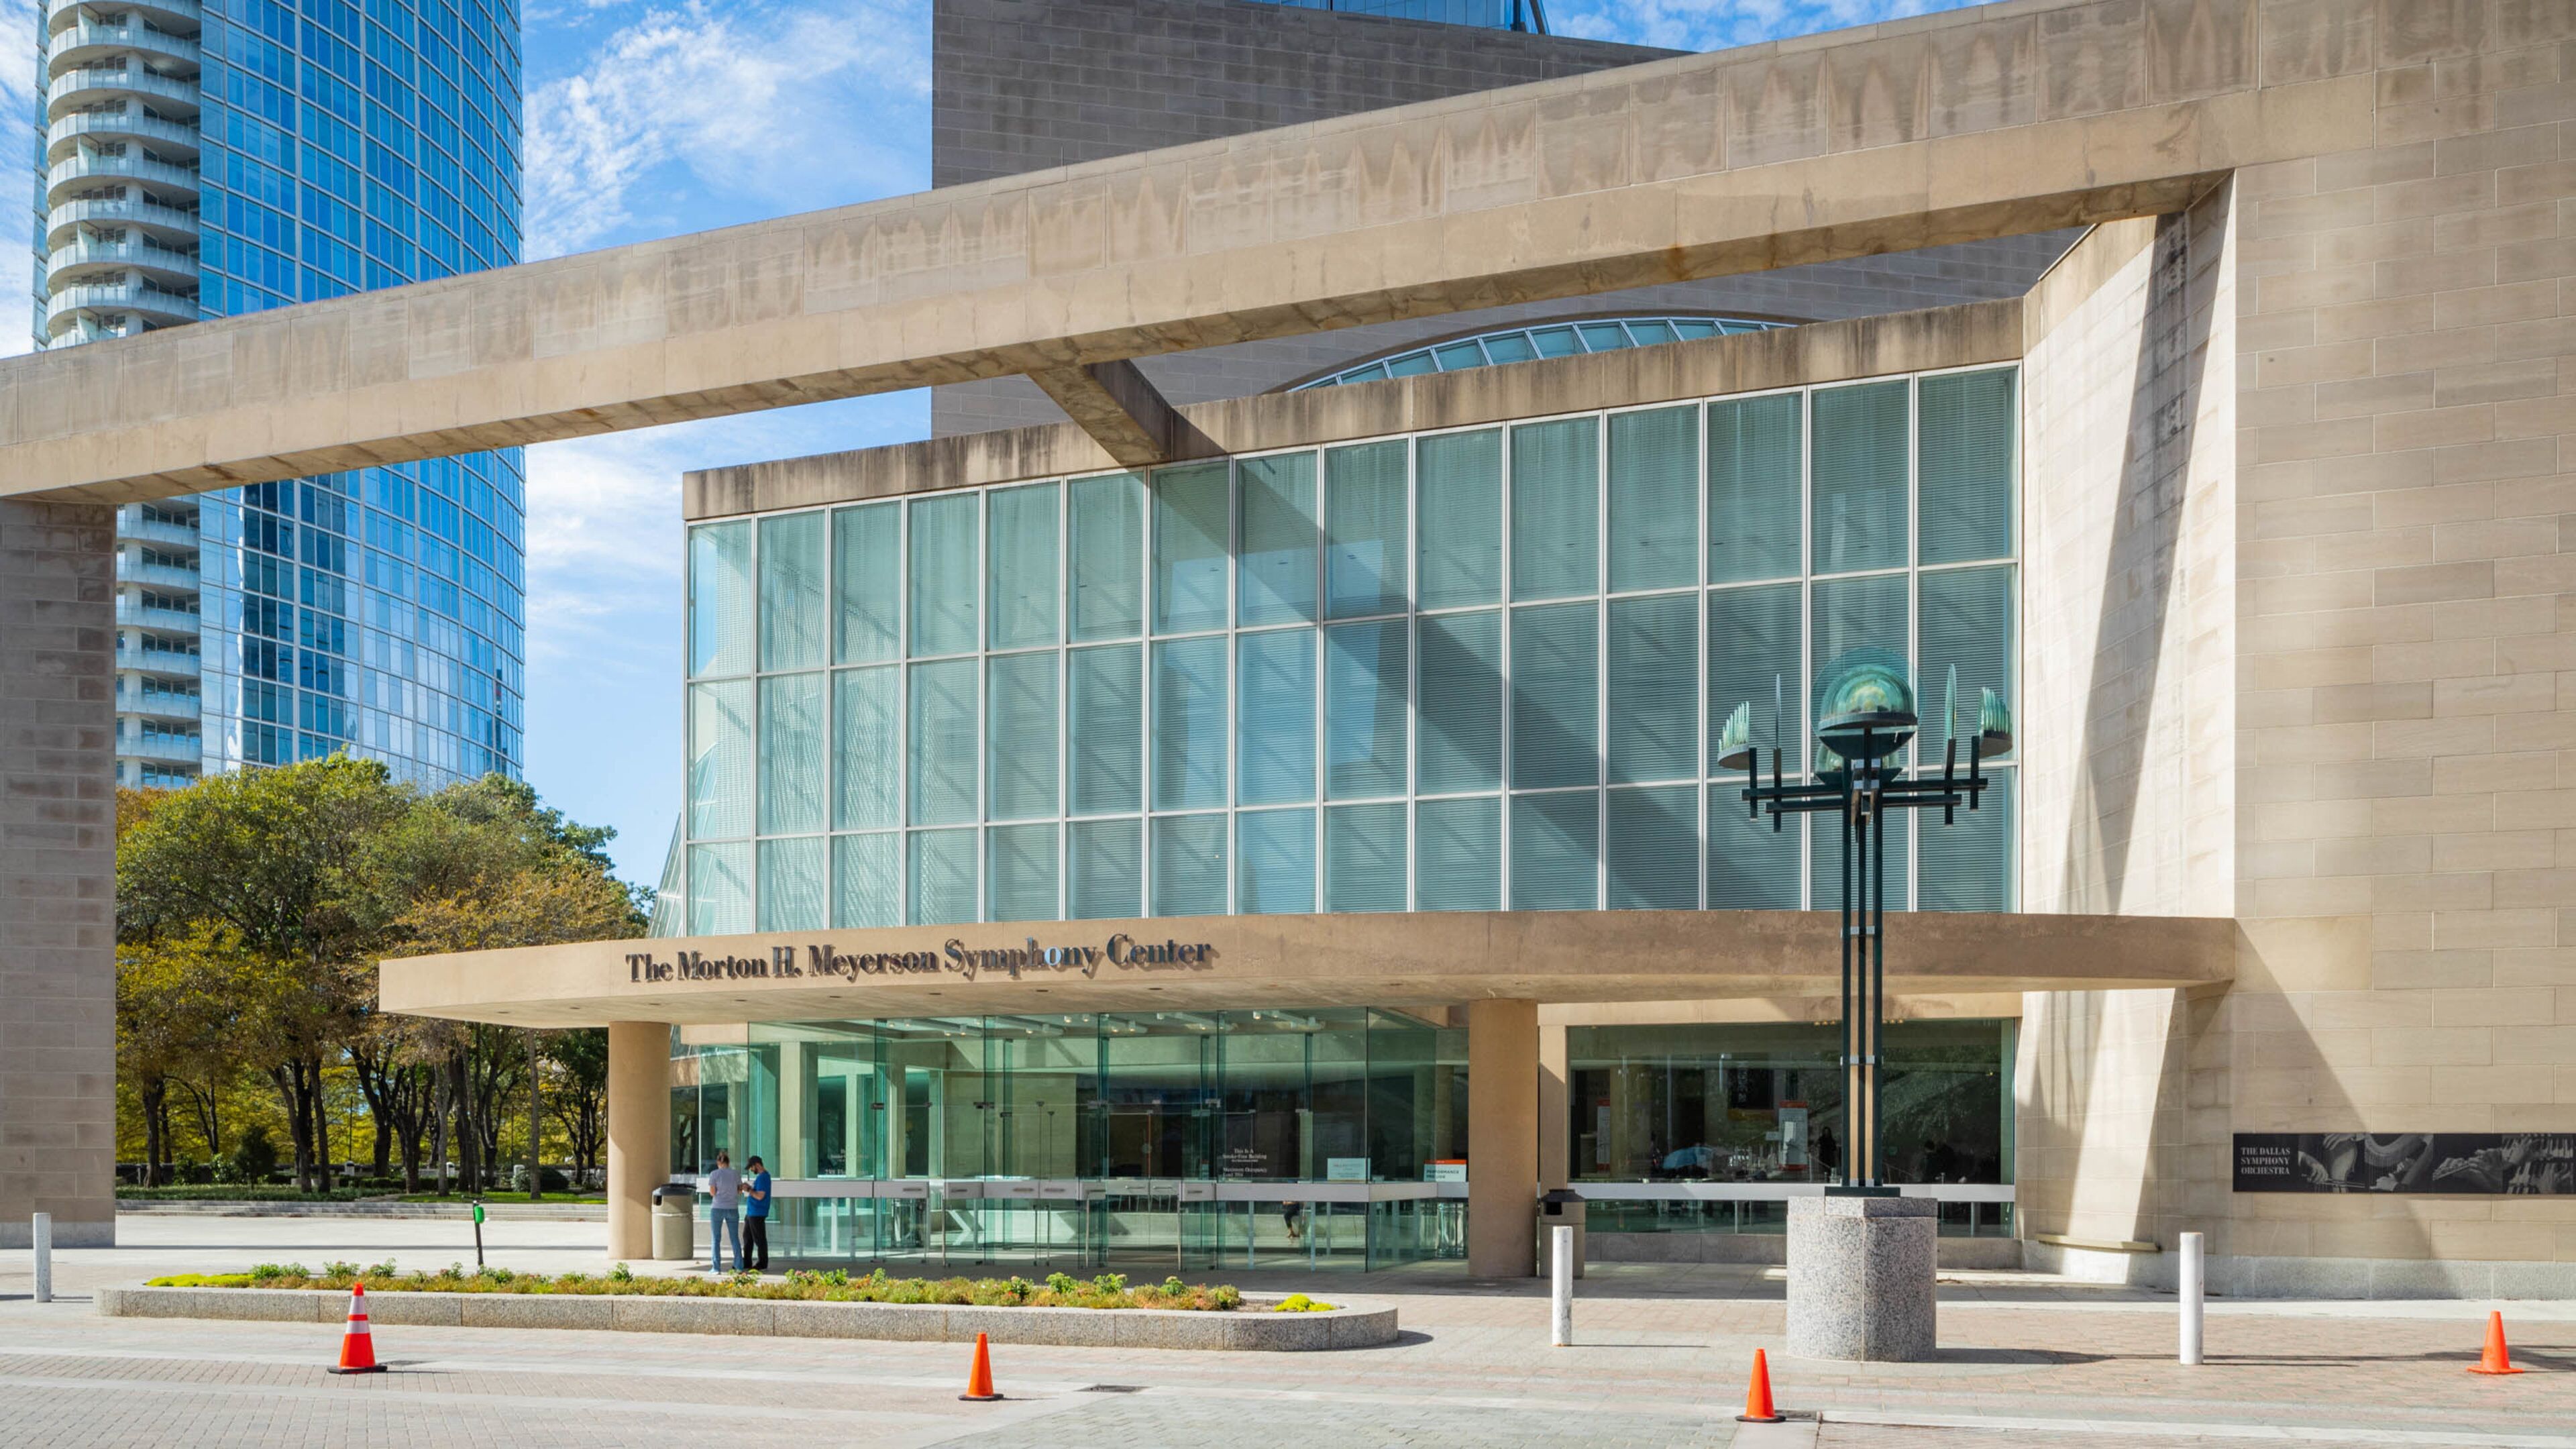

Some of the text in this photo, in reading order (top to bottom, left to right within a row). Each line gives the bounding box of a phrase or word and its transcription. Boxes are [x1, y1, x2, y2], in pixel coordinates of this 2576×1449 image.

[626, 933, 1210, 983] The Morton H. Meyerson Symphony Center
[2241, 1146, 2290, 1155] THE DALLAS
[2241, 1157, 2290, 1165] SYMPHONY
[2241, 1167, 2290, 1175] ORCHESTRA
